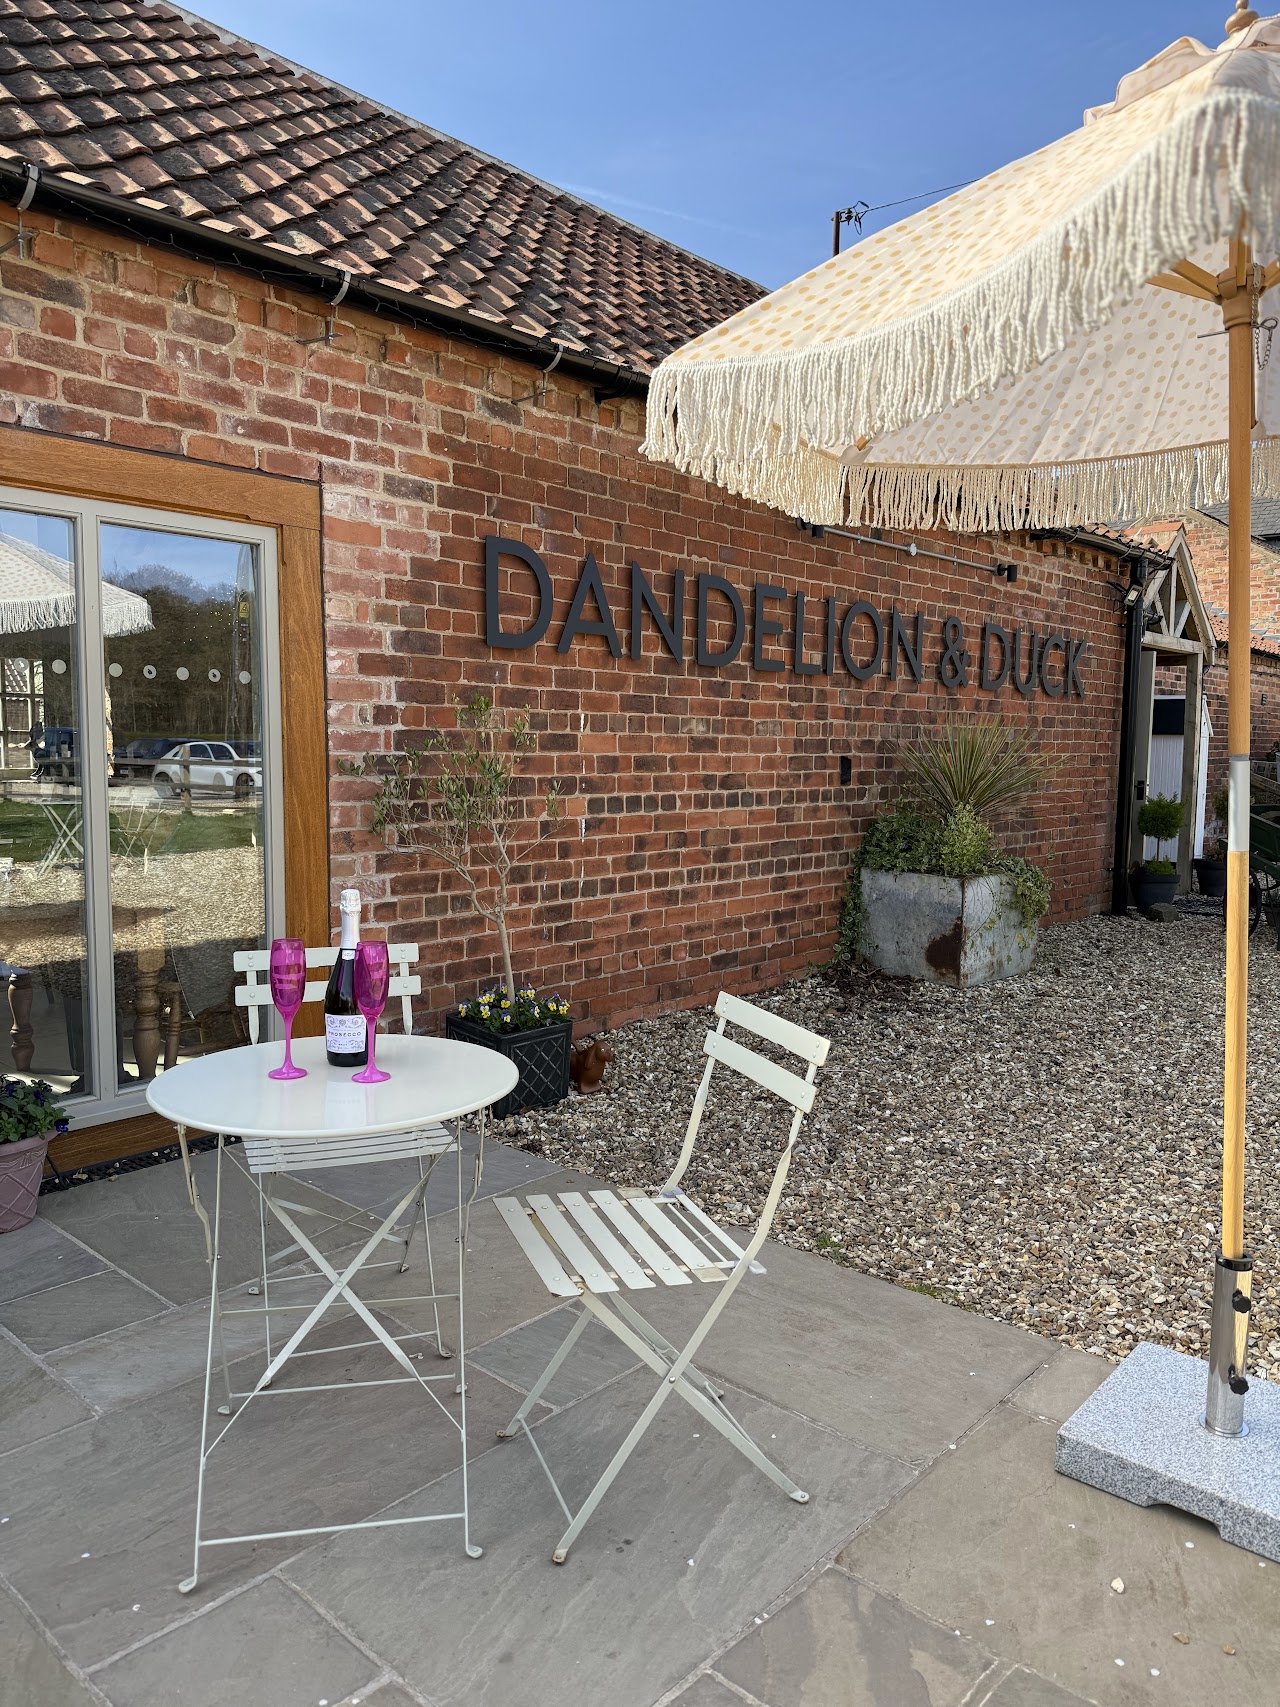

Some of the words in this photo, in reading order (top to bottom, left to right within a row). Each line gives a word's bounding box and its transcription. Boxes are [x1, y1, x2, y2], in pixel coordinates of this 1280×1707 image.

[485, 536, 924, 683] DANDELION
[941, 616, 969, 688] &
[982, 623, 1087, 698] DUCK
